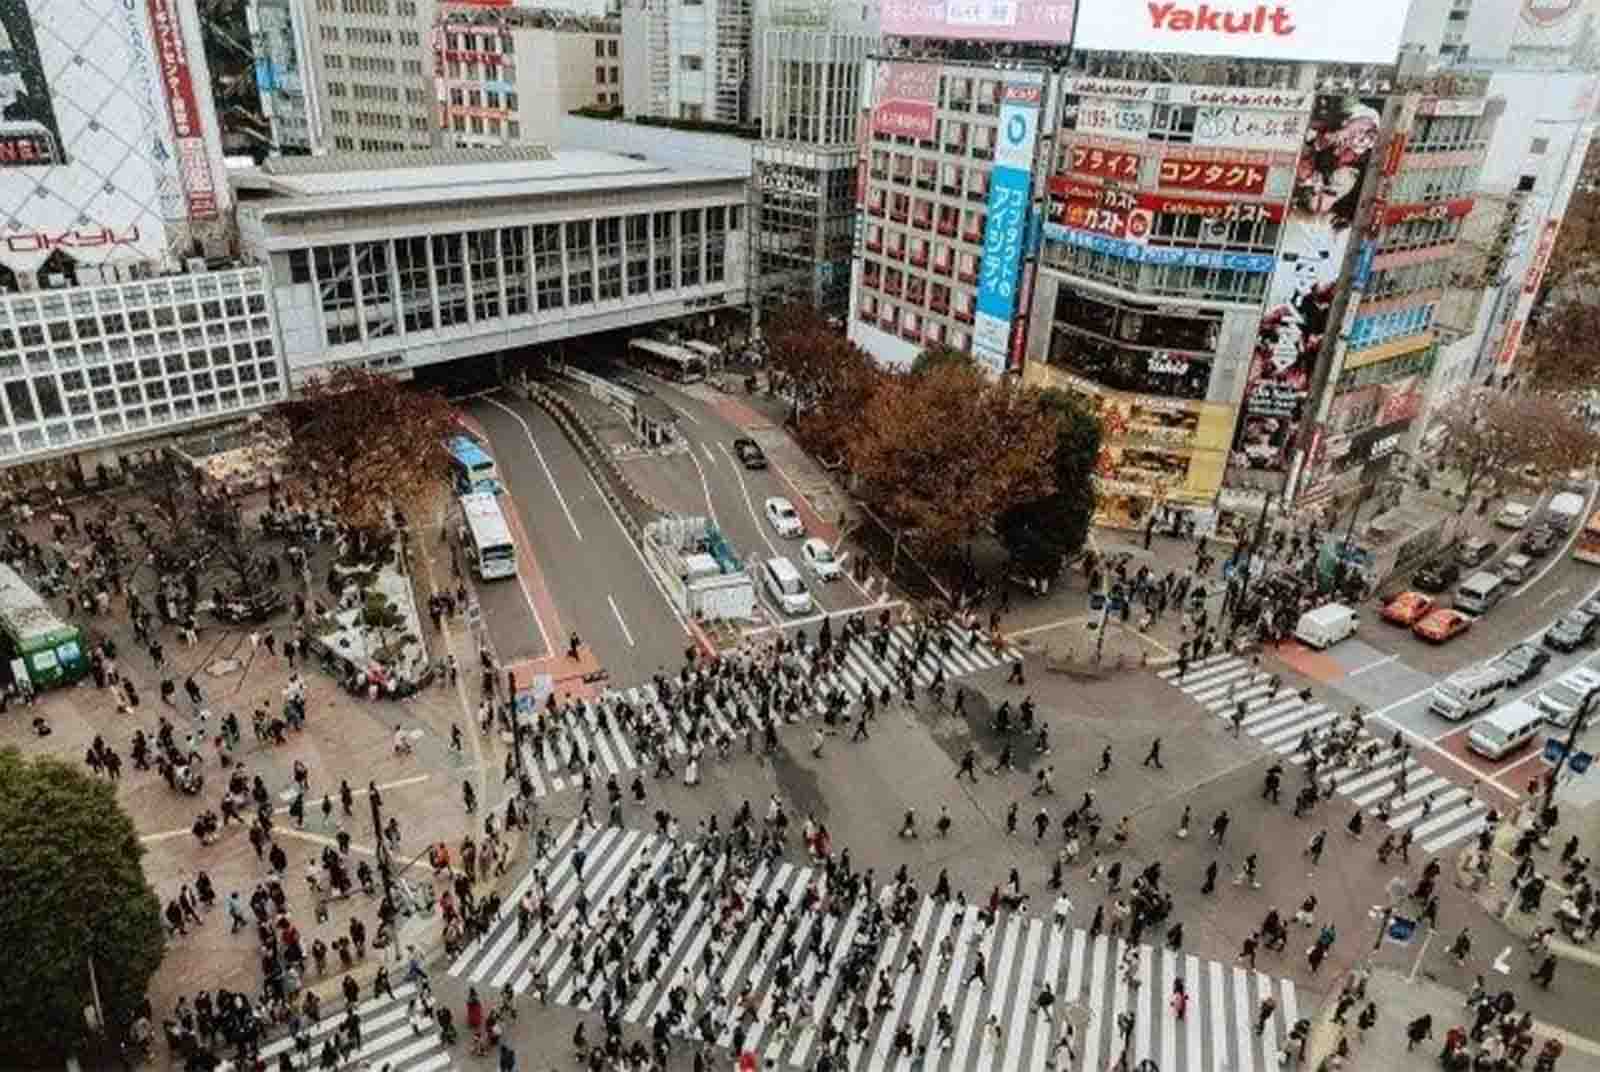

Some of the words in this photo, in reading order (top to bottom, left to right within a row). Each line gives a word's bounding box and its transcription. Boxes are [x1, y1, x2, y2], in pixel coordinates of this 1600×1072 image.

[1147, 2, 1296, 35] Yakult
[1161, 161, 1264, 187] コンタクト
[1084, 207, 1124, 233] ガスト
[1224, 203, 1273, 222] ガスト
